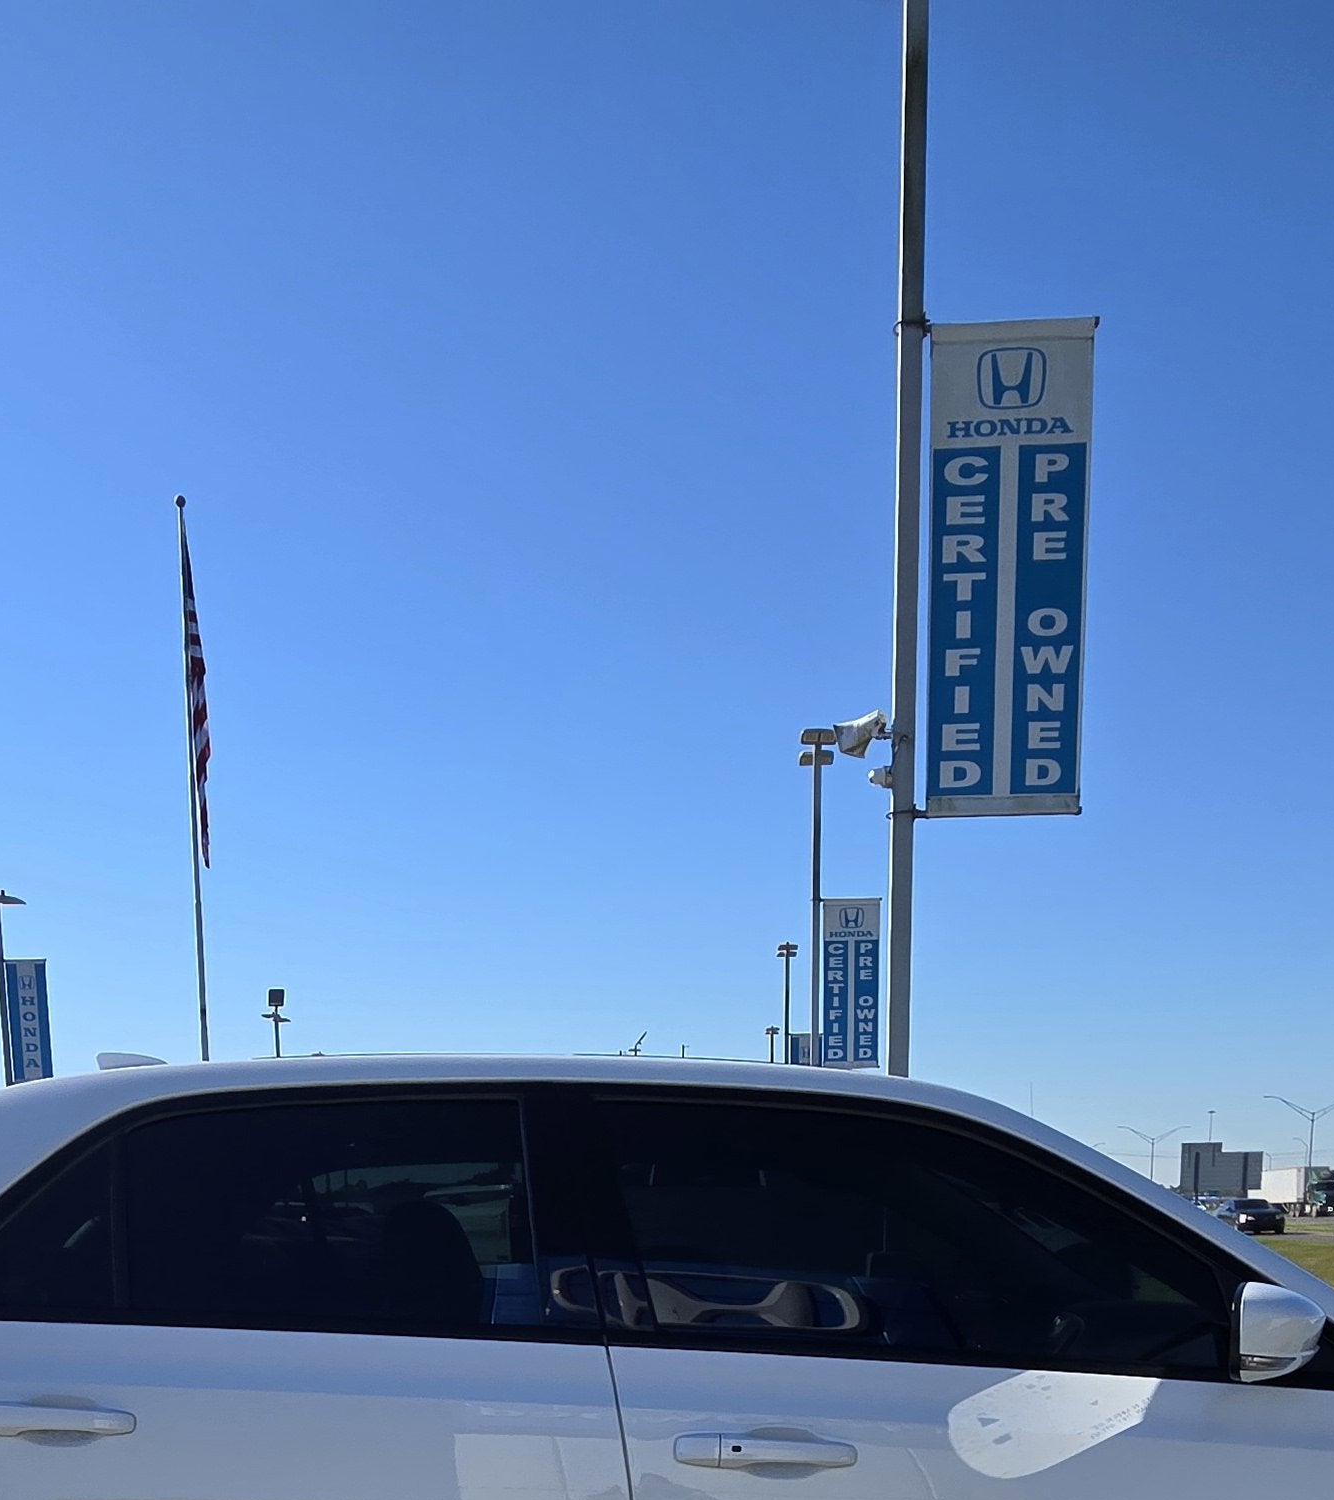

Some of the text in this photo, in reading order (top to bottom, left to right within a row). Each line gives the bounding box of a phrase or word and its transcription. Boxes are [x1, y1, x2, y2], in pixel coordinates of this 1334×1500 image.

[947, 417, 1074, 439] HONDA
[939, 455, 989, 788] CERTIFIED
[1020, 453, 1073, 786] PRE OWNED
[829, 930, 874, 938] HONDA
[21, 996, 40, 1068] HONDA
[827, 943, 844, 1059] CERTIFIED
[856, 942, 875, 1058] PRE OWNED
